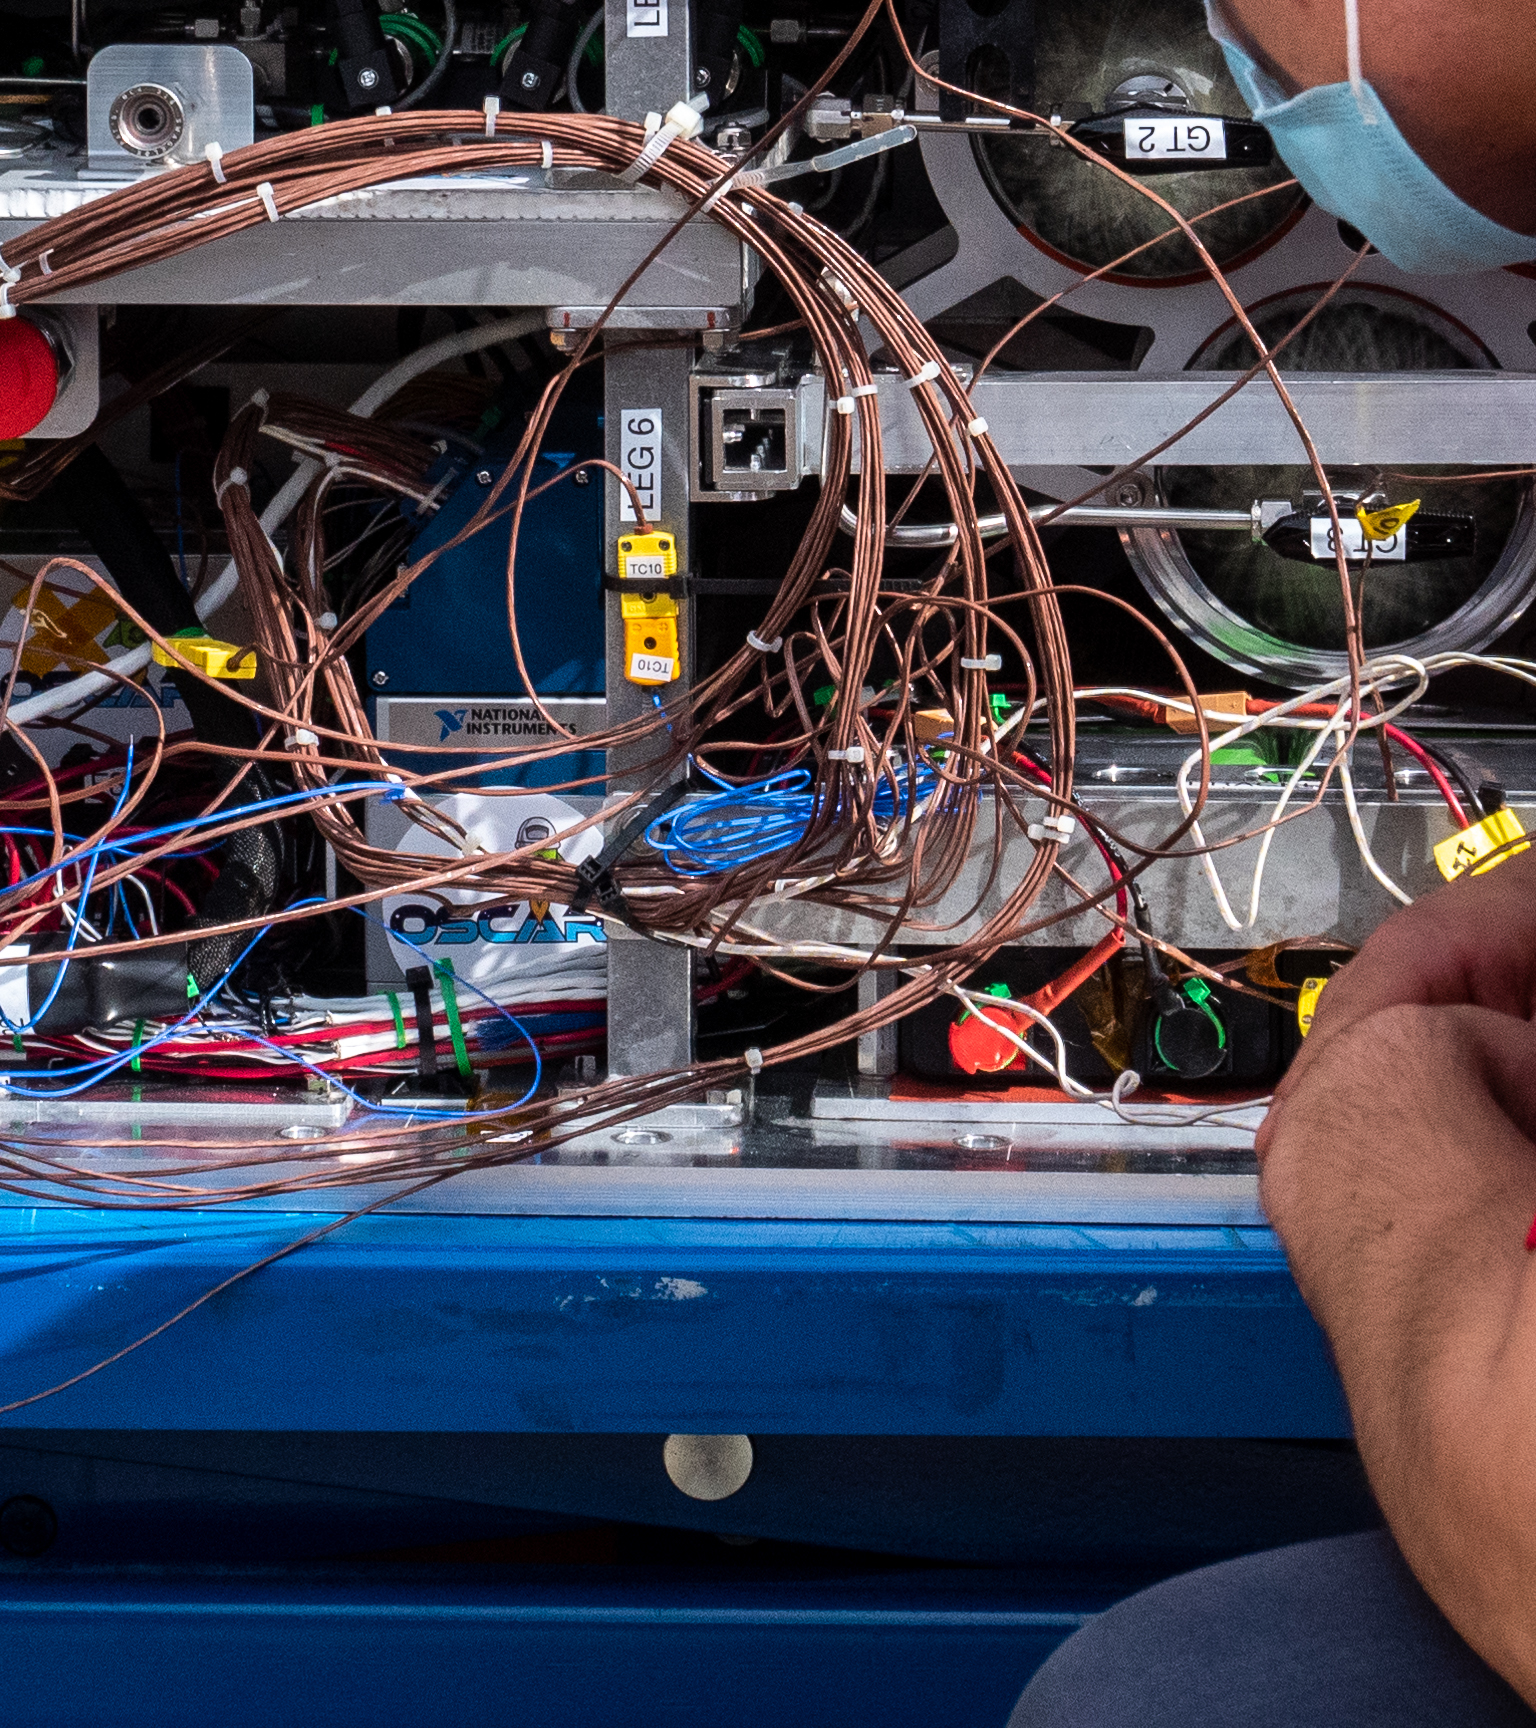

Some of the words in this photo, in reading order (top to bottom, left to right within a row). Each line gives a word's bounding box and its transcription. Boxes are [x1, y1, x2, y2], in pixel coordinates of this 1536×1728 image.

[1138, 126, 1156, 153] 2
[1166, 125, 1211, 153] GT
[627, 417, 655, 436] 6
[627, 446, 654, 510] LEG
[629, 563, 663, 575] TC10
[637, 658, 670, 674] TC10
[389, 903, 608, 945] OSCAR
